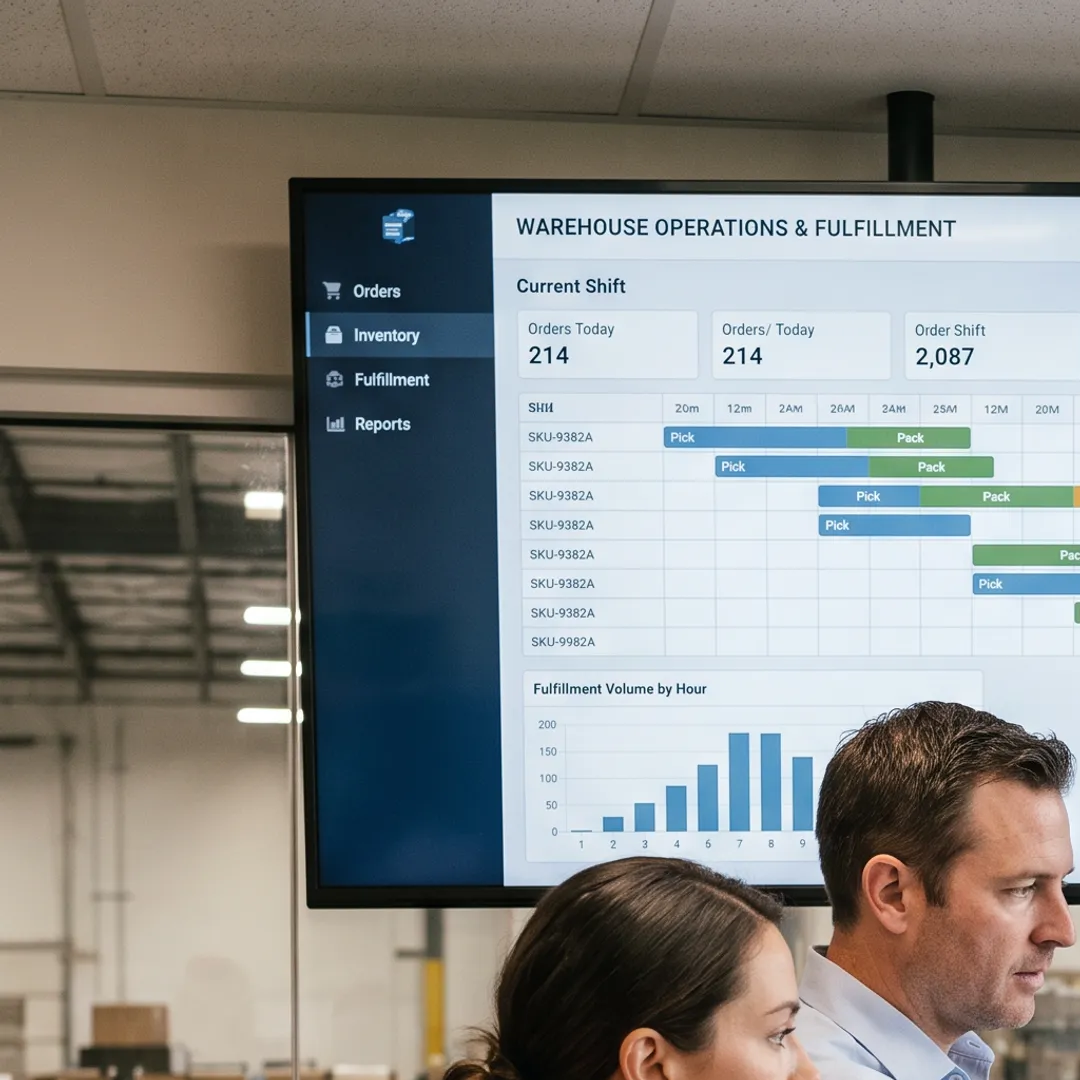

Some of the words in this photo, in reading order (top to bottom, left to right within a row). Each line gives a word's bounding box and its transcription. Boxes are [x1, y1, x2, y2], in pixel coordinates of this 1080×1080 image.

[517, 218, 648, 235] WAREHOUSE
[655, 219, 787, 236] OPERATIONS
[795, 220, 807, 236] &
[816, 220, 956, 237] FULFILLMENT
[517, 279, 580, 293] Current
[586, 278, 625, 293] Shift
[354, 284, 401, 298] Orders
[529, 322, 571, 335] Orders
[577, 323, 614, 338] Today
[723, 323, 771, 336] Orders/
[776, 323, 814, 338] Today
[916, 324, 950, 336] Order
[955, 324, 985, 336] Shift
[355, 328, 420, 345] Inventory
[529, 346, 569, 364] 214
[723, 347, 762, 364] 214
[916, 348, 974, 369] 2,087
[356, 372, 429, 386] Fulfillment
[676, 404, 699, 413] 20m
[728, 404, 752, 413] 12m
[780, 404, 802, 413] 2AM
[985, 405, 1008, 414] 12M
[1036, 405, 1059, 414] 20M
[356, 417, 411, 433] Reports
[529, 432, 592, 442] SKU-9382A
[671, 432, 695, 442] Pick
[898, 433, 924, 443] Pack
[529, 461, 593, 471] SKU-9382A
[722, 461, 745, 472] Pick
[918, 461, 945, 472] Pack
[530, 491, 593, 500] SKU-9382A
[857, 491, 880, 501] Pick
[983, 491, 1010, 502] Pack
[530, 520, 593, 530] SKU-9382A
[826, 520, 849, 530] Pick
[530, 550, 594, 559] SKU-9382A
[531, 579, 595, 588] SKU-9382A
[979, 578, 1002, 589] Pick
[531, 608, 595, 618] SKU-9382A
[532, 637, 595, 647] SKU-9982A
[534, 683, 601, 694] Fulfillment
[606, 683, 653, 694] Volume
[658, 683, 672, 697] by
[677, 683, 706, 694] Hour
[539, 720, 556, 729] 200
[540, 747, 557, 756] 150
[540, 774, 557, 783] 100
[546, 801, 557, 809] 50
[552, 827, 558, 836] 0
[579, 840, 583, 848] 1
[611, 840, 616, 849] 2
[643, 840, 647, 848] 3
[674, 840, 679, 848] 4
[737, 839, 743, 847] 7
[768, 839, 774, 848] 8
[800, 839, 805, 848] 9
